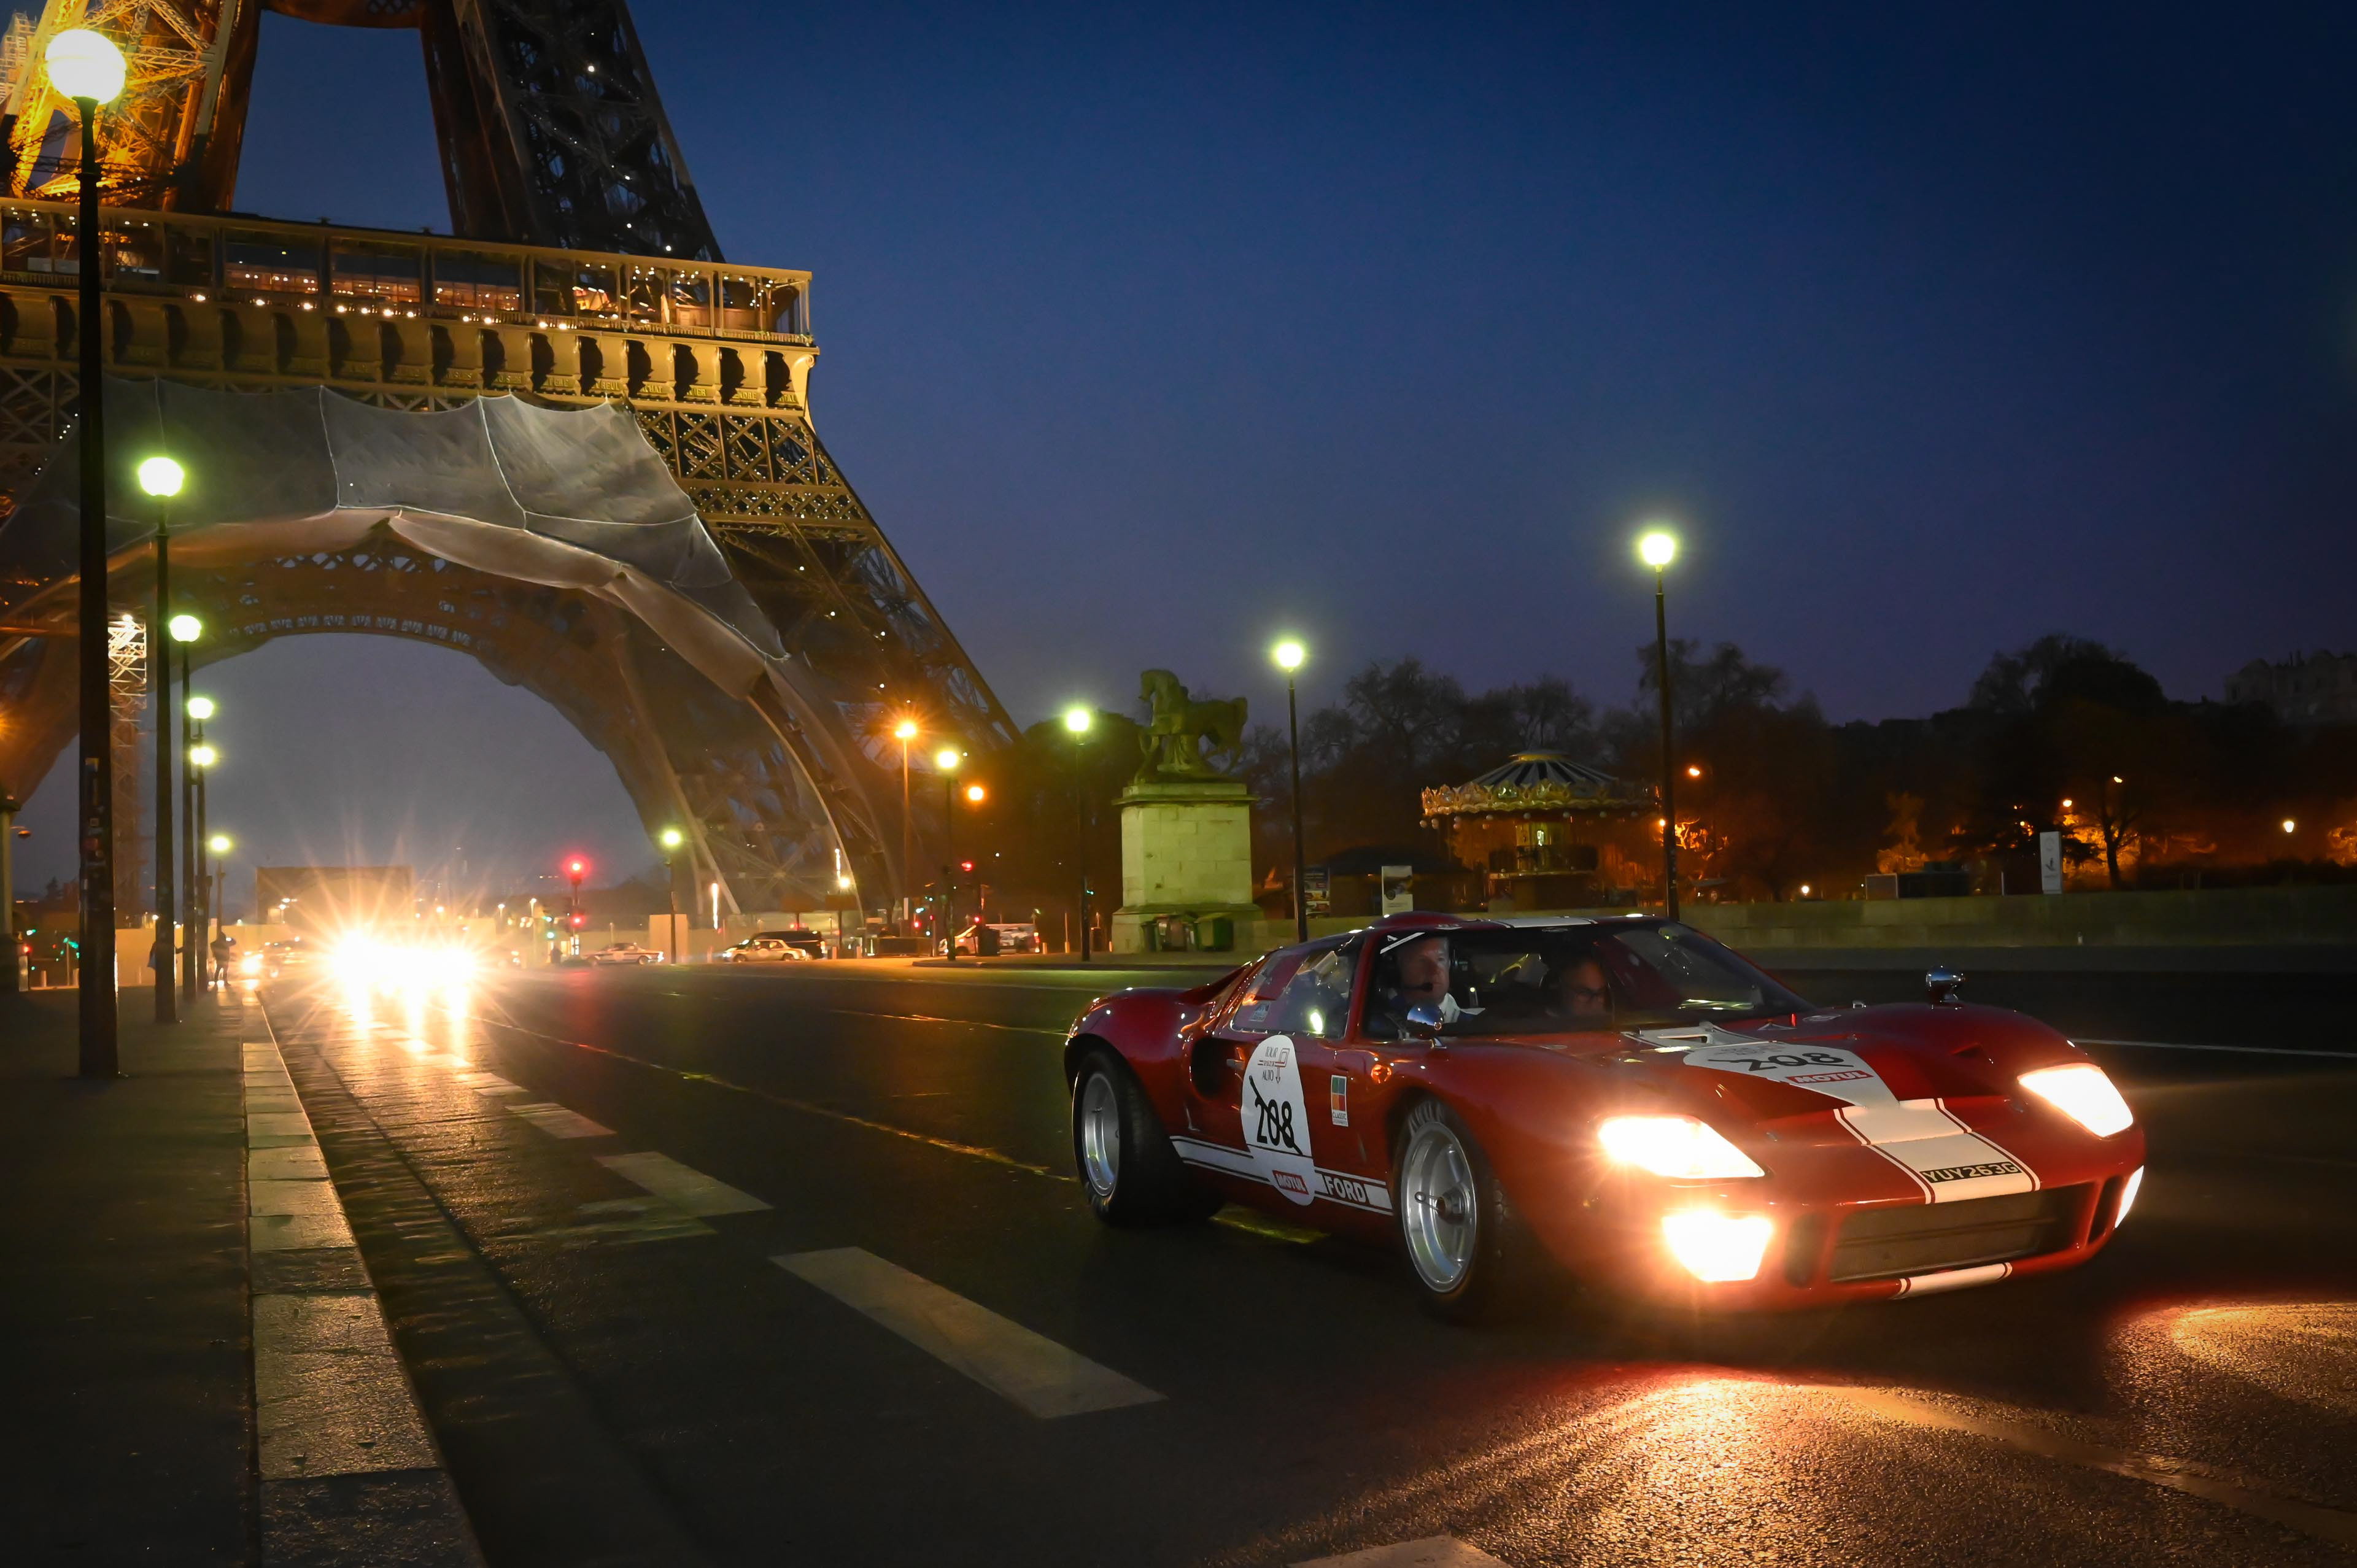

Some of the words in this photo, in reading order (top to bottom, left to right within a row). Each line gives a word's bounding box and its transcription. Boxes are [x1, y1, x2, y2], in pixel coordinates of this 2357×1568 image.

[1731, 1052, 1844, 1072] 208
[1795, 1070, 1868, 1084] MOTUL
[1254, 1097, 1295, 1149] 208
[1922, 1163, 2019, 1182] YUY263G
[1275, 1173, 1307, 1192] MOTUL
[1324, 1175, 1366, 1203] FORD
